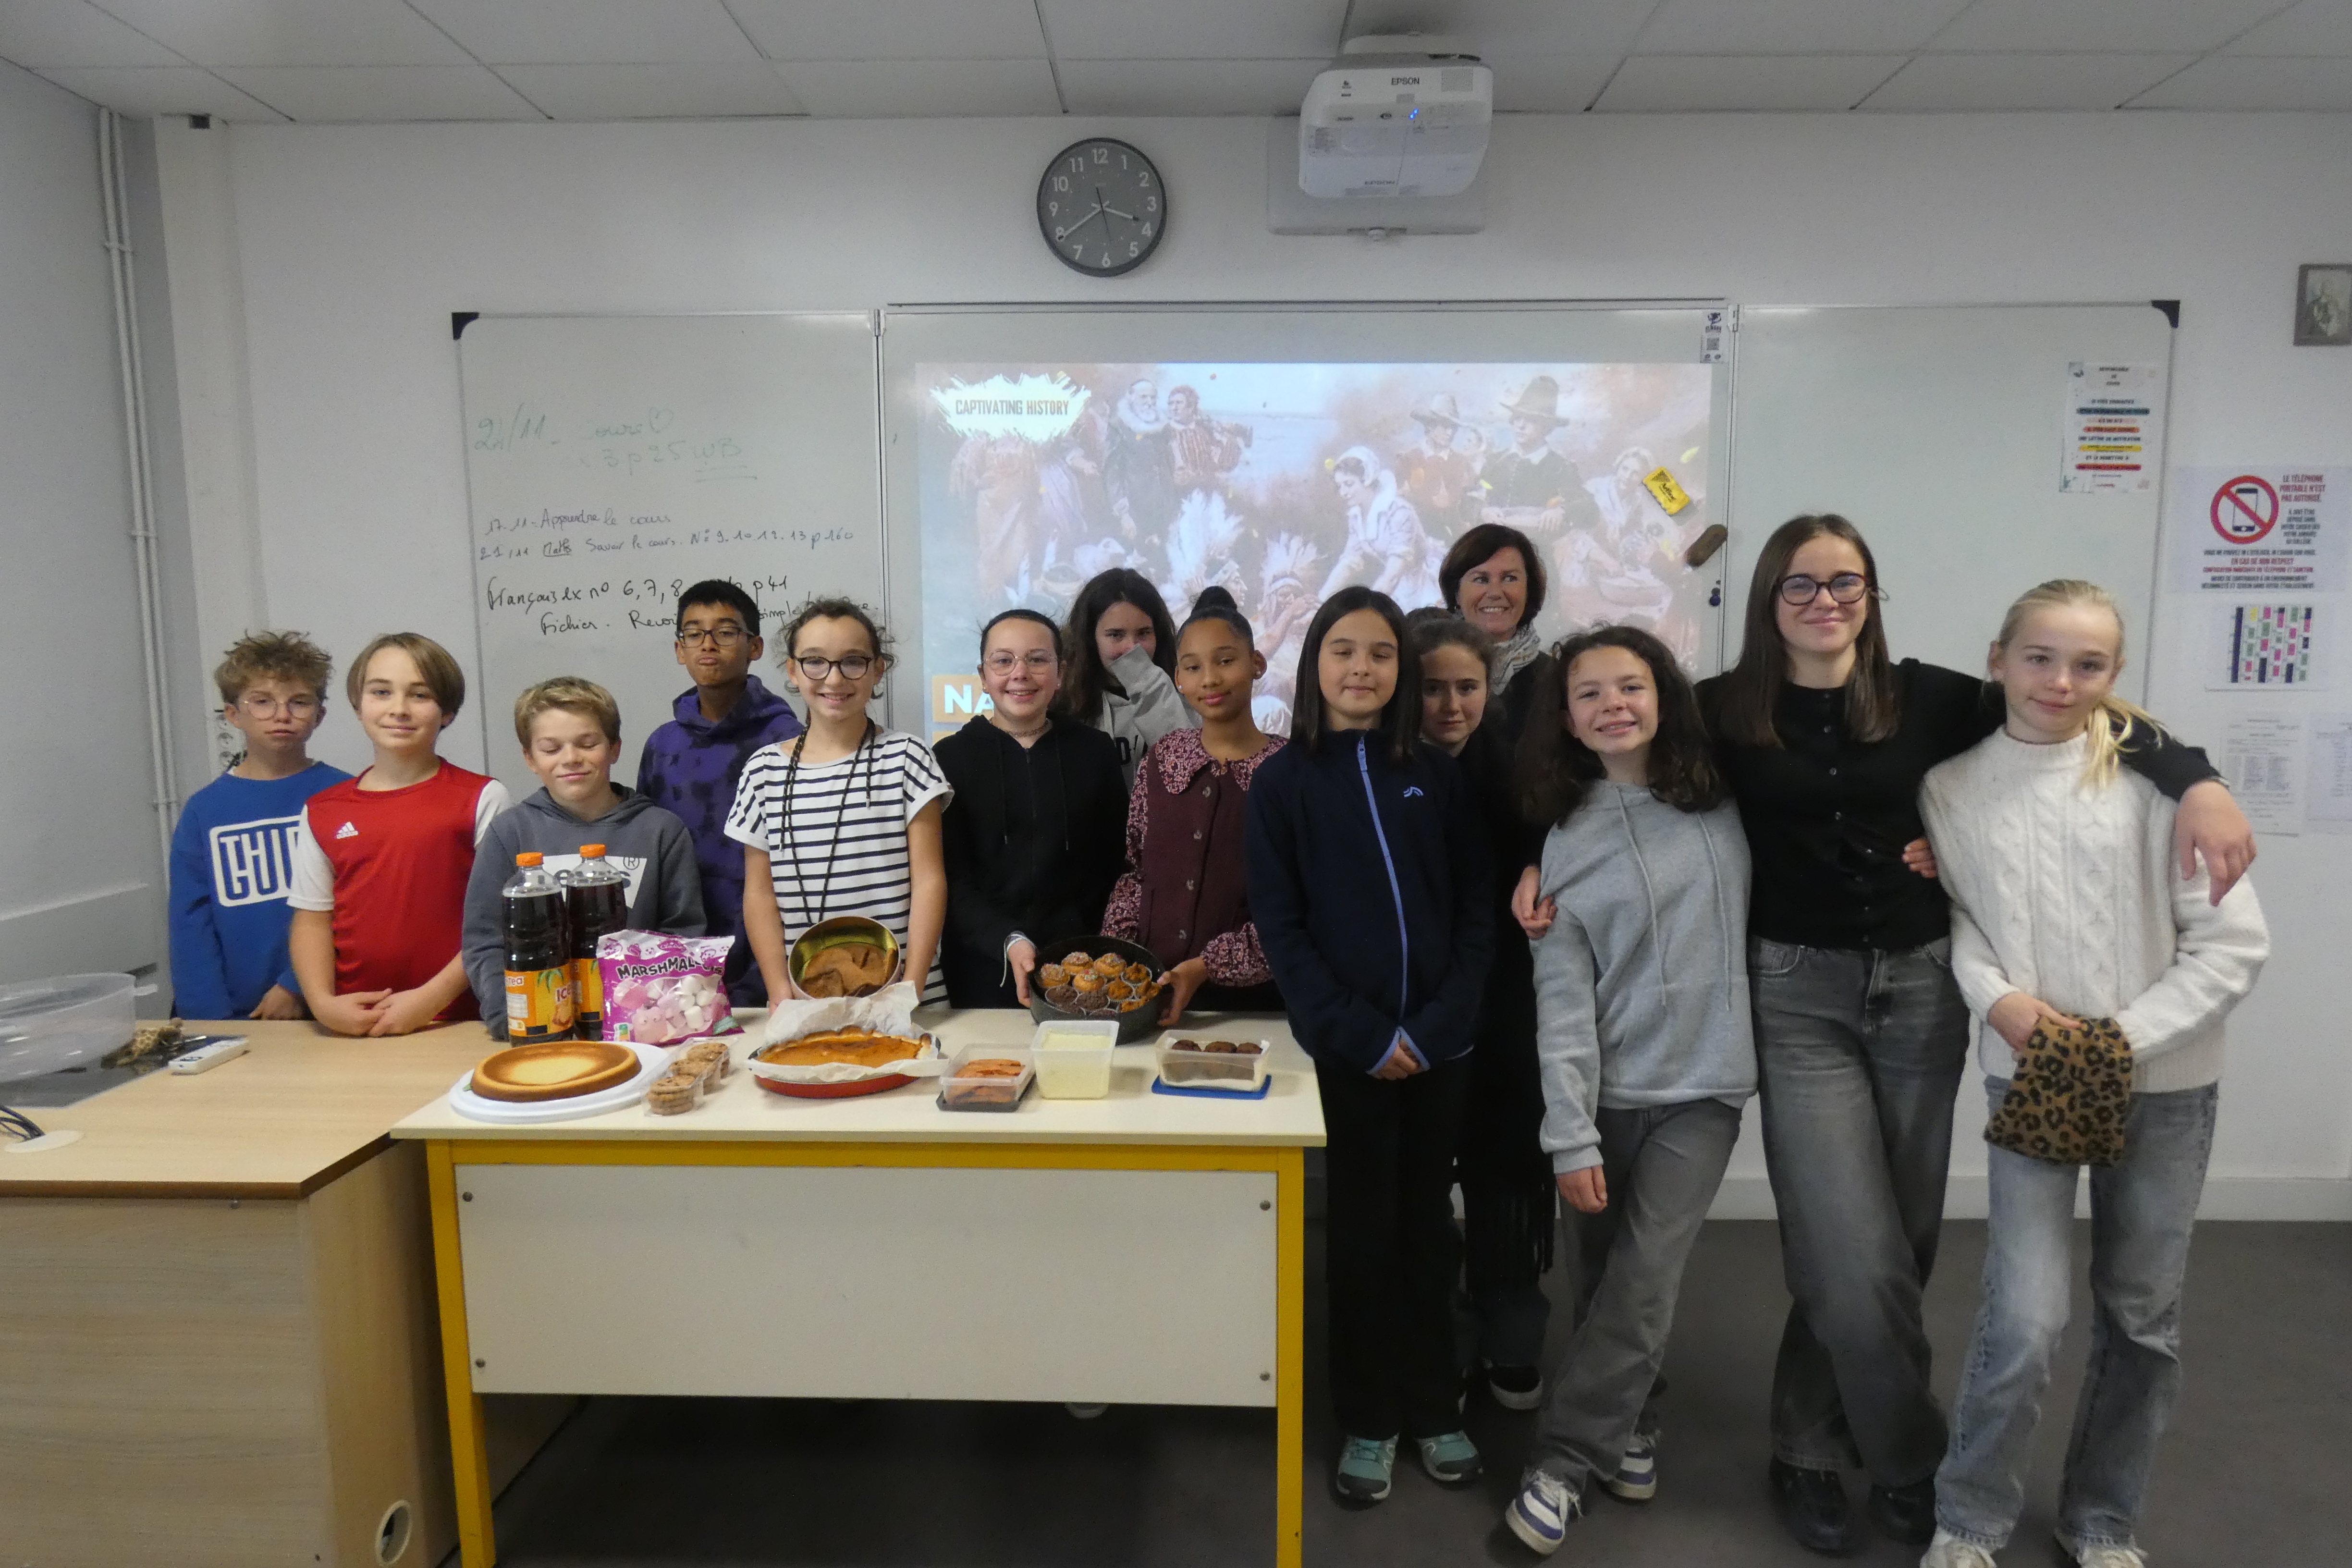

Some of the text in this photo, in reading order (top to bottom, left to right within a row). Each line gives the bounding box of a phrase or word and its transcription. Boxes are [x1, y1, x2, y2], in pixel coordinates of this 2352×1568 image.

[1391, 77, 1420, 86] EPSON
[1092, 147, 1108, 164] 12
[1121, 155, 1127, 170] 1
[1069, 157, 1084, 173] 11
[1052, 176, 1069, 192] 10
[1139, 172, 1150, 187] 2
[1049, 201, 1058, 217] 9
[1147, 196, 1157, 212] 3
[1055, 226, 1065, 242] 8
[1141, 221, 1152, 237] 4
[1073, 244, 1083, 260] 7
[1129, 241, 1139, 257] 5
[1102, 252, 1111, 268] 6
[955, 399, 1069, 415] CAPTIVATING HISTORY
[604, 507, 619, 526] le
[630, 514, 671, 526] cours
[791, 530, 807, 541] 13
[768, 575, 787, 591] 41
[628, 609, 677, 629] Revoi
[944, 684, 994, 714] NA
[616, 956, 724, 980] MARSHMALS
